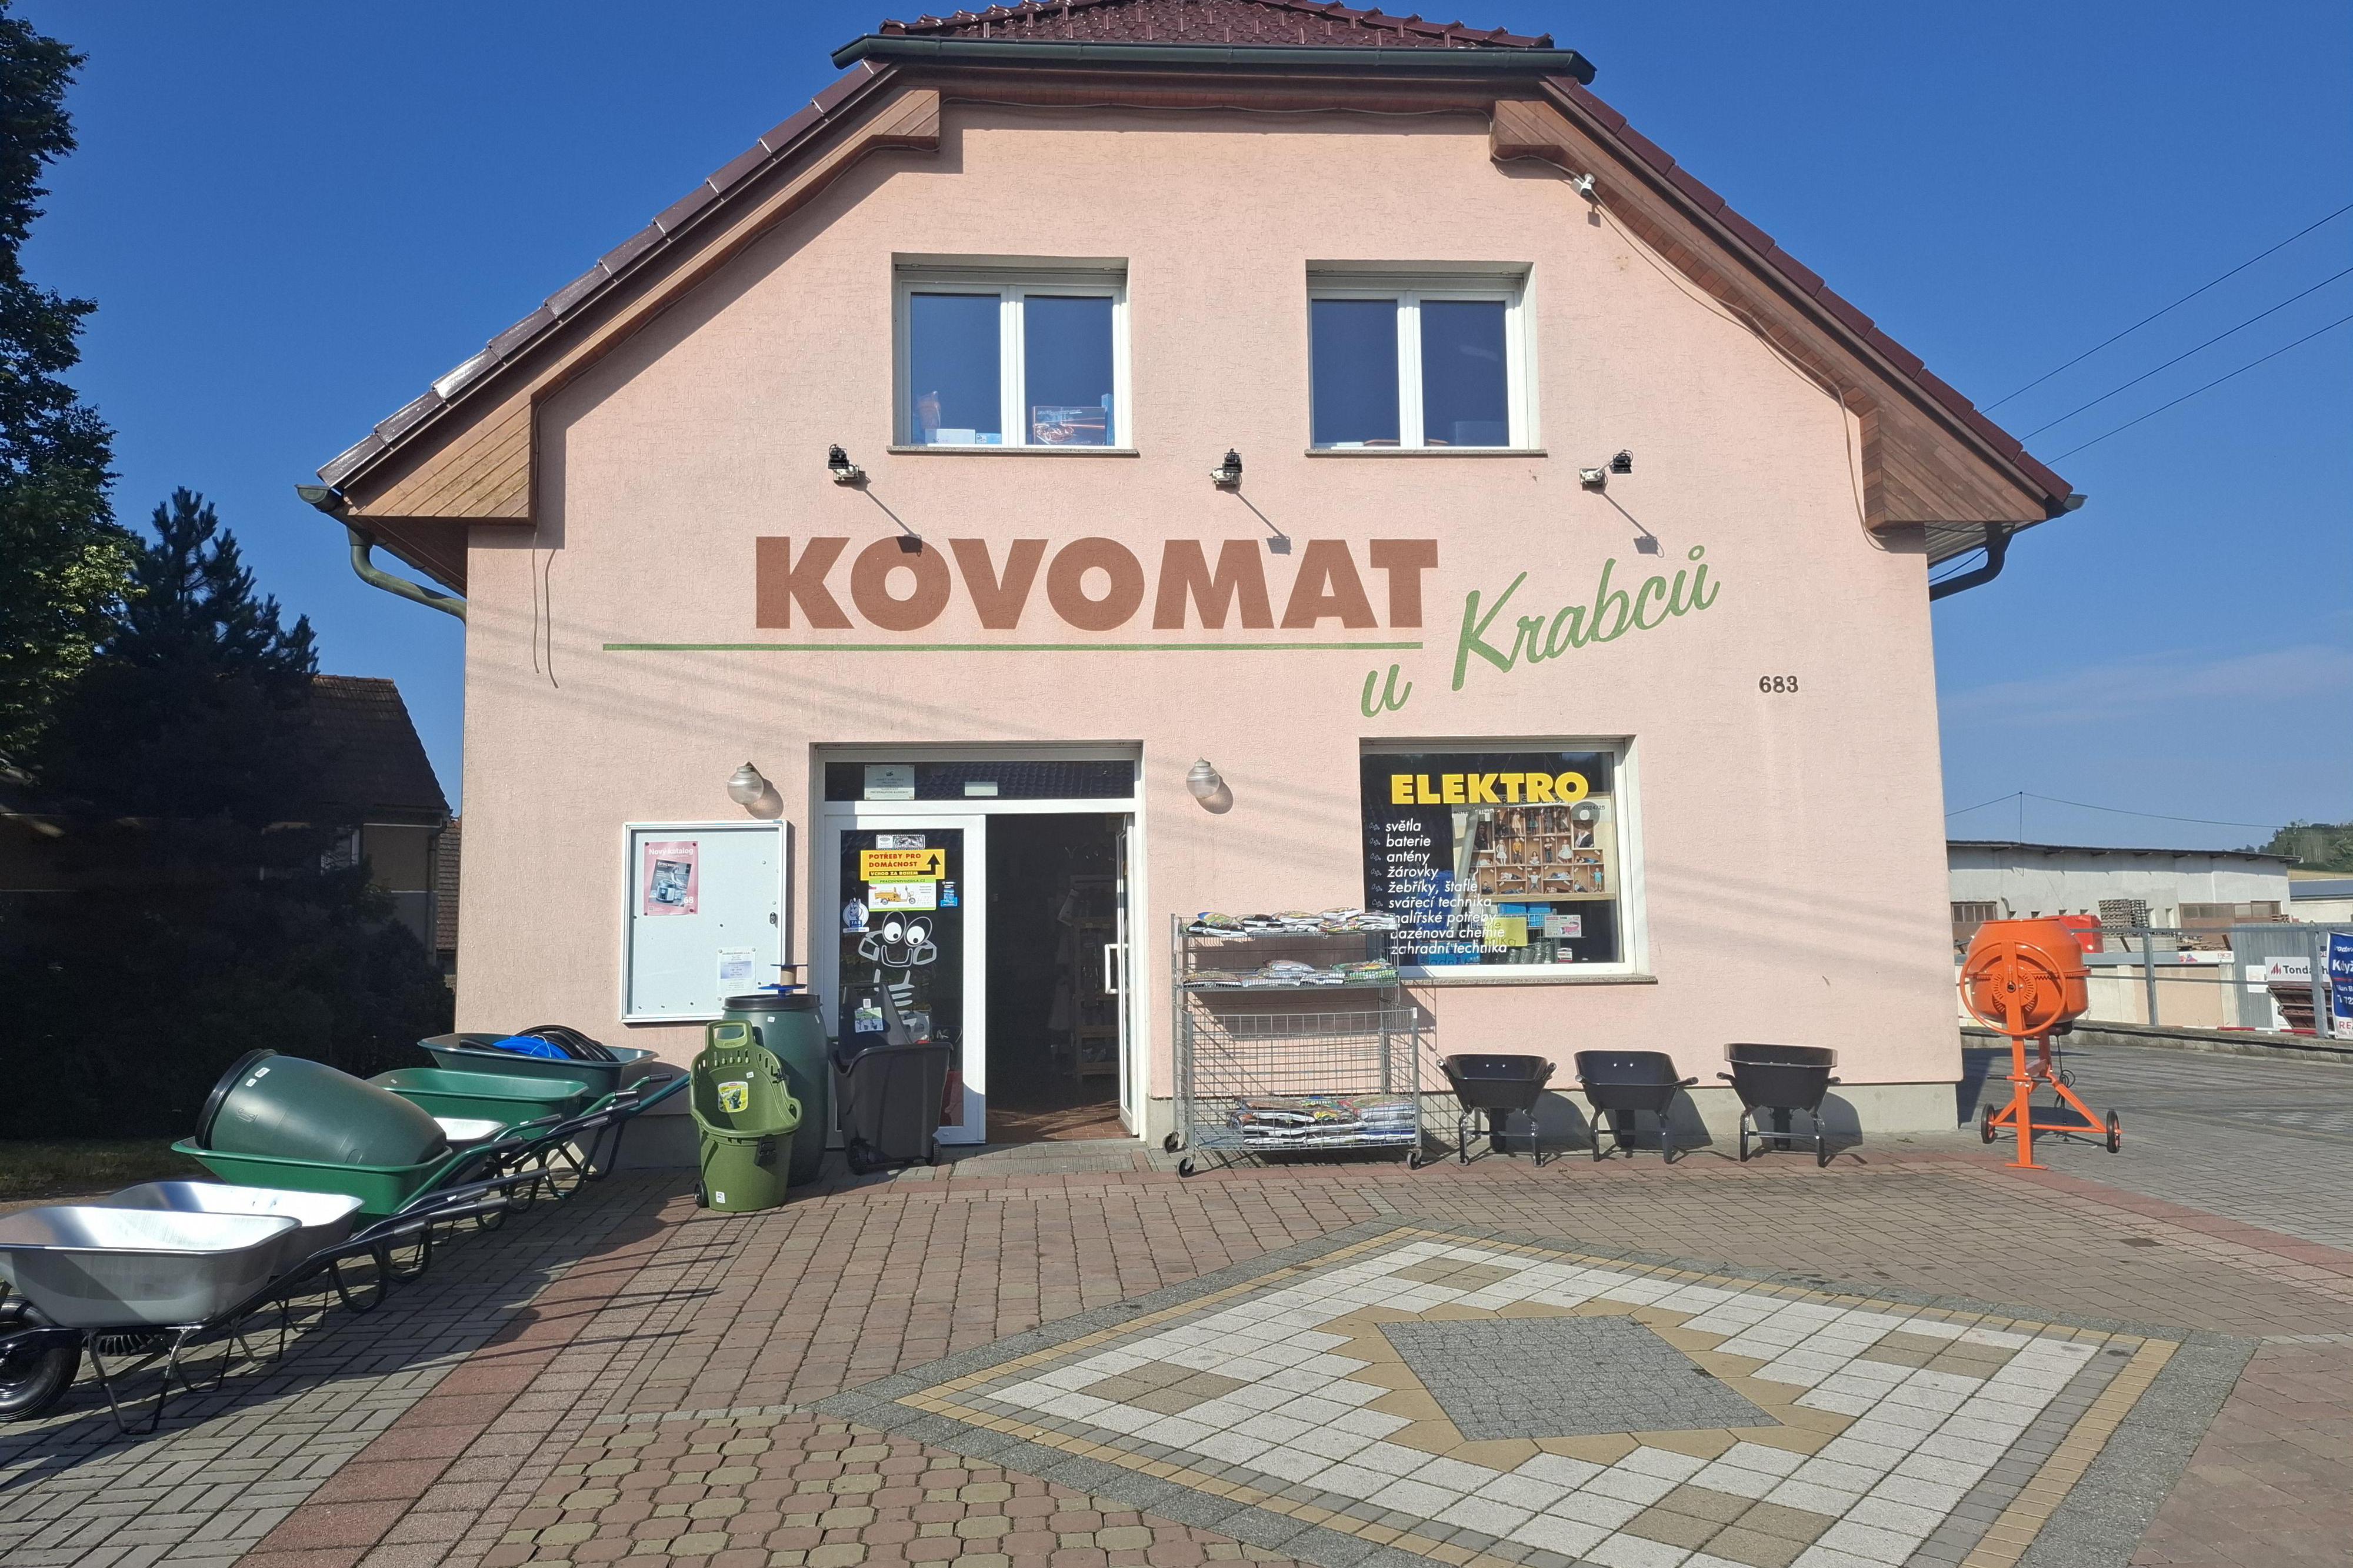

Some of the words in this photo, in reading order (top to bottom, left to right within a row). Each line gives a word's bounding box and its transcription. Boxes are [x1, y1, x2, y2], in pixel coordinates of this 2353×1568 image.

[756, 536, 1438, 632] KOVOMAT
[1361, 663, 1412, 718] u
[1451, 545, 1721, 692] Krabců
[1758, 675, 1799, 693] 683
[1391, 772, 1589, 805] ELEKTRO
[1385, 818, 1421, 832] světla
[1386, 833, 1431, 847] baterie
[1387, 850, 1431, 866] antény
[1387, 863, 1439, 880] žárovky
[1388, 879, 1439, 896] žebříky,
[1444, 879, 1478, 892] štafle
[1388, 896, 1436, 908] svářecí
[1438, 894, 1492, 908] technika
[1447, 909, 1496, 927] potřeby
[1459, 925, 1505, 939] chemie
[1390, 940, 1451, 955] zahradní
[1454, 940, 1507, 954] technika
[2282, 965, 2328, 975] Tondh
[2339, 1021, 2353, 1029] RE
